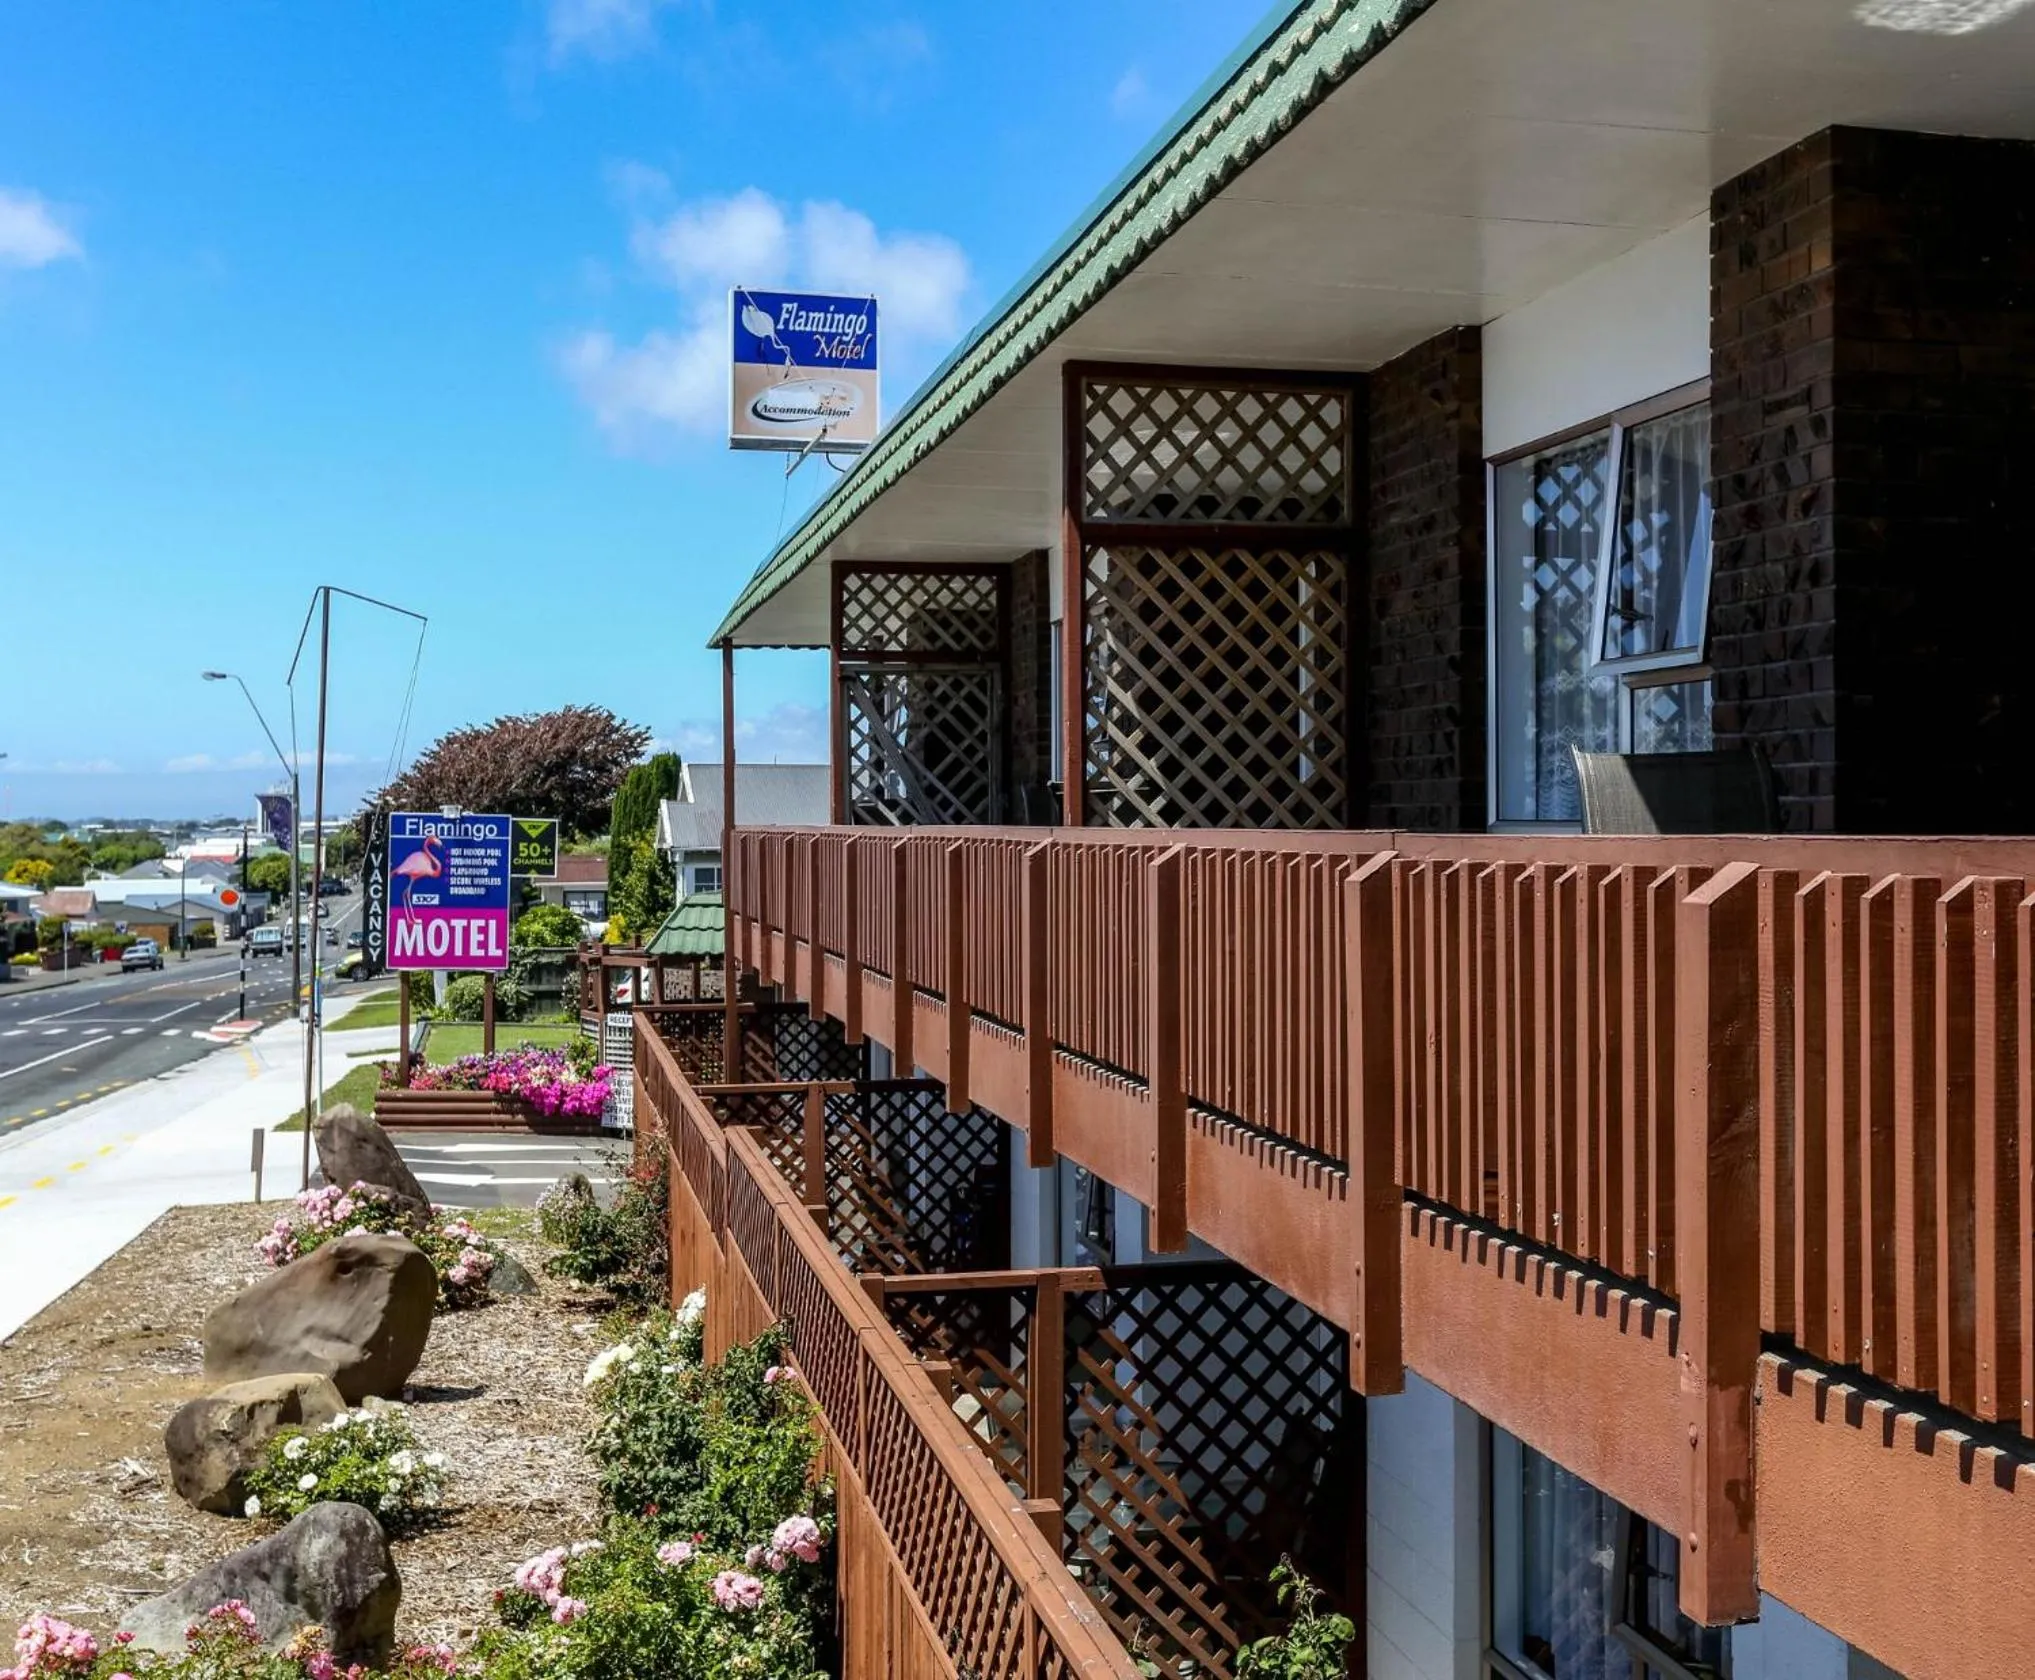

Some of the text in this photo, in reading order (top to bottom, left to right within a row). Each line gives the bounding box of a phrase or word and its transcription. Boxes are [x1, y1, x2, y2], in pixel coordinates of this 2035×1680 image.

[776, 302, 868, 341] Flamingo
[813, 332, 873, 361] Motel
[405, 818, 498, 842] Flamingo
[483, 858, 498, 867] POOL
[487, 848, 502, 857] POOL
[513, 858, 554, 866] CHANNELS
[450, 876, 472, 886] SECURE
[368, 852, 384, 962] VACANCY
[394, 917, 503, 958] MOTEL
